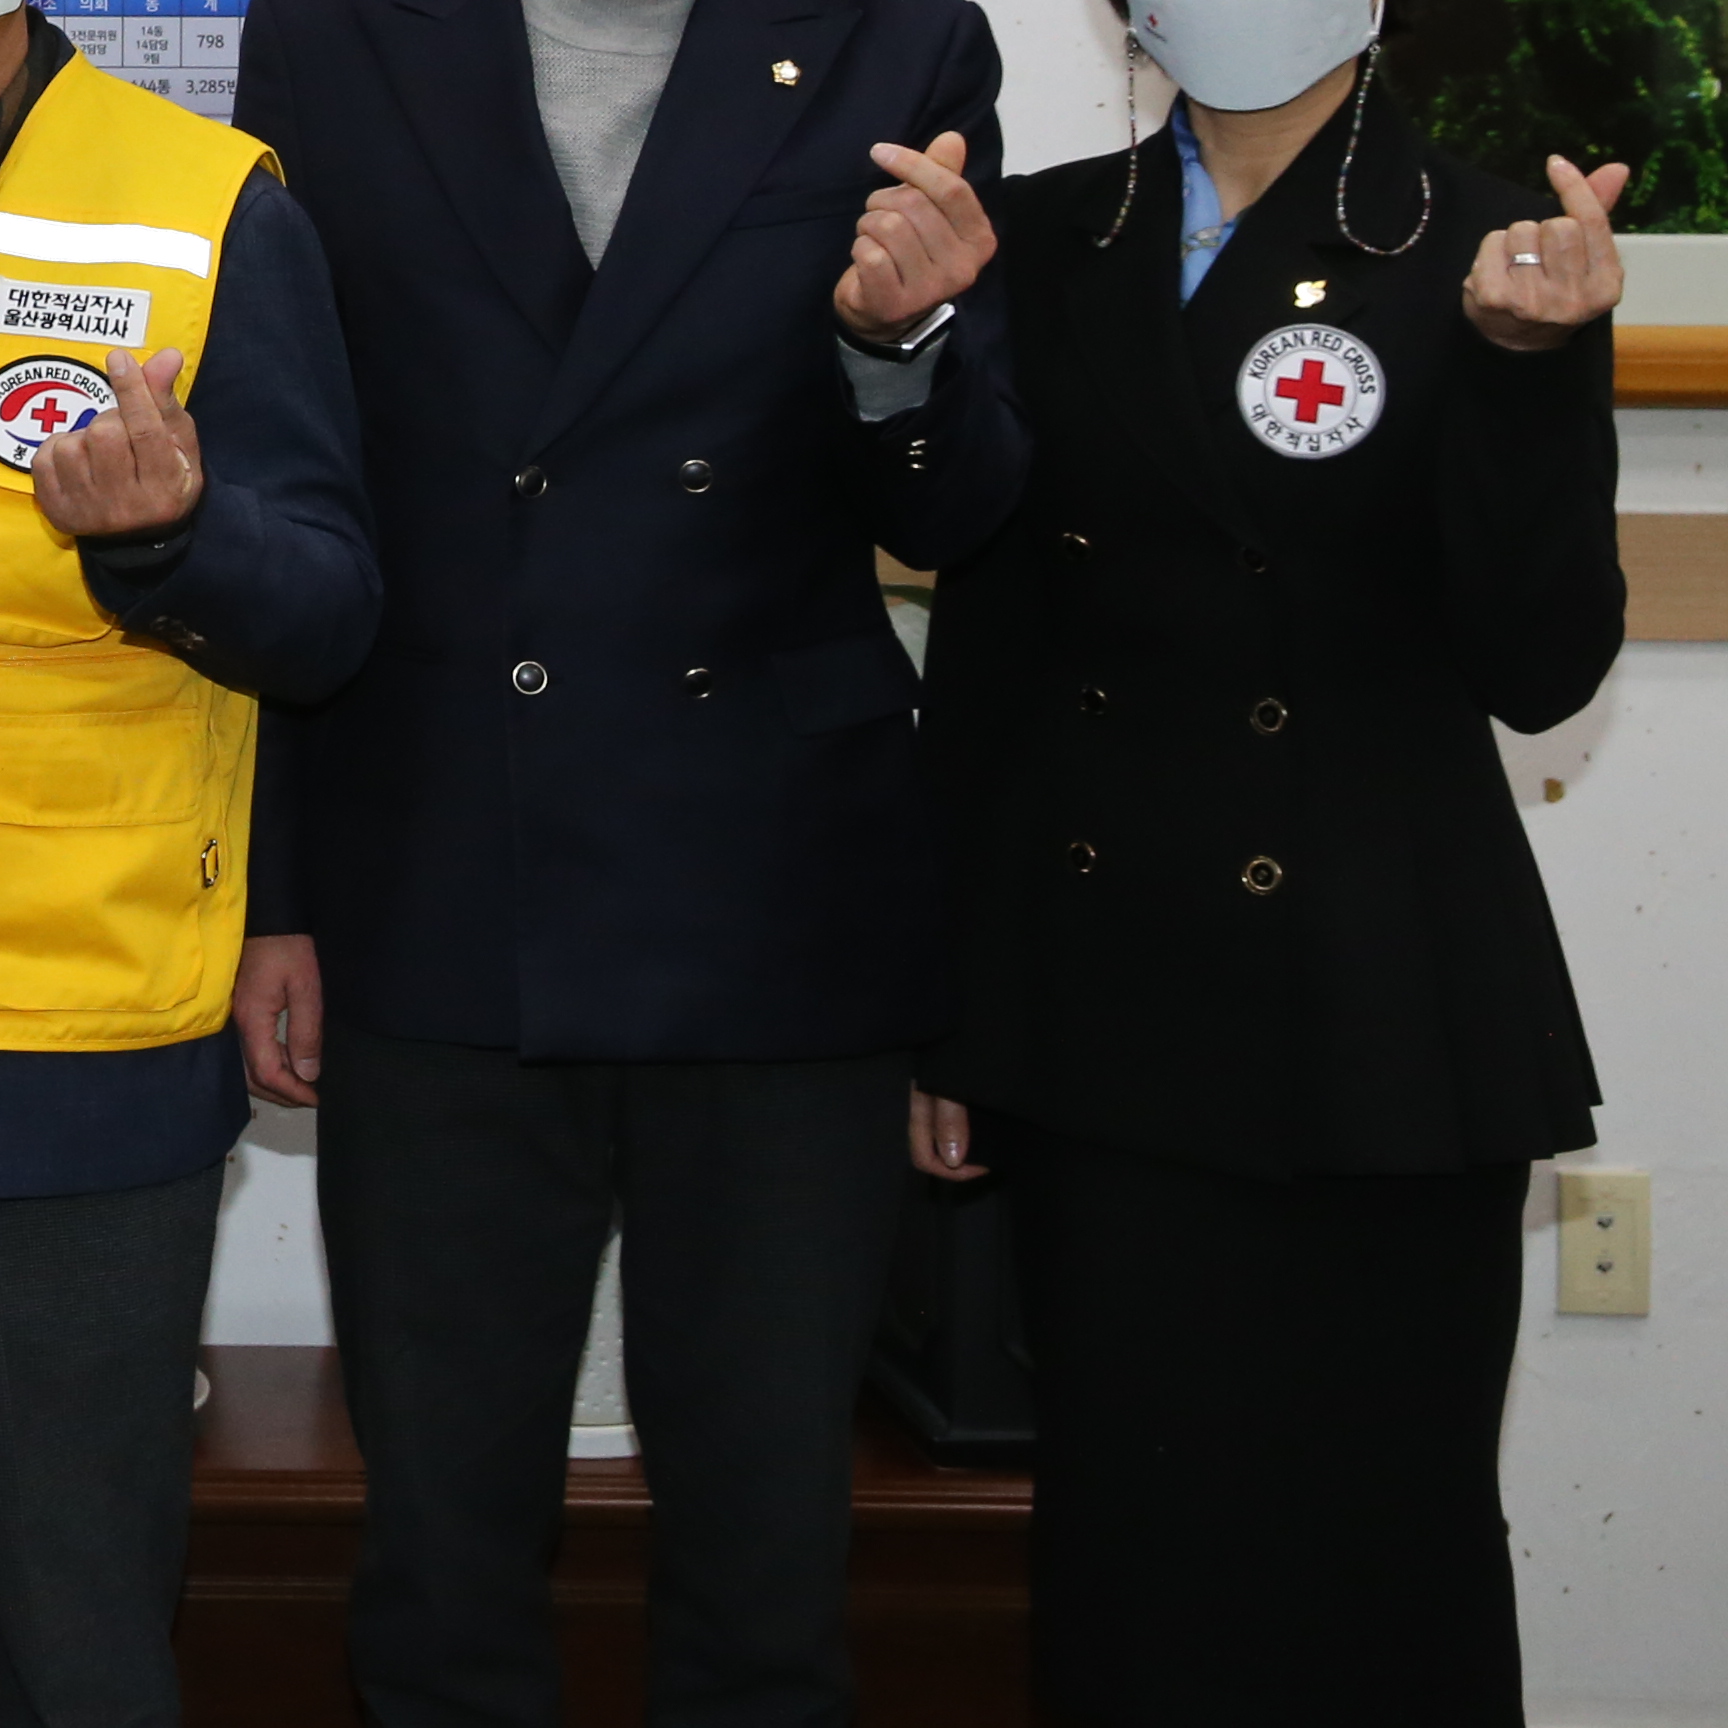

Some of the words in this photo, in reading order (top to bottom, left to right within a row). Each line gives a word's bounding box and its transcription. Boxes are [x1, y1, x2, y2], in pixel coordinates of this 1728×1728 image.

[136, 40, 168, 50] 14담당
[142, 26, 163, 37] 14동
[197, 35, 224, 48] 798
[9, 288, 135, 318] 대한적십자사
[3, 309, 129, 339] 울산광역시지사
[1248, 333, 1305, 380] KOREAN
[1311, 331, 1343, 352] RED
[1344, 348, 1375, 394] CROSS
[46, 367, 70, 381] RED
[72, 373, 110, 404] CROSS
